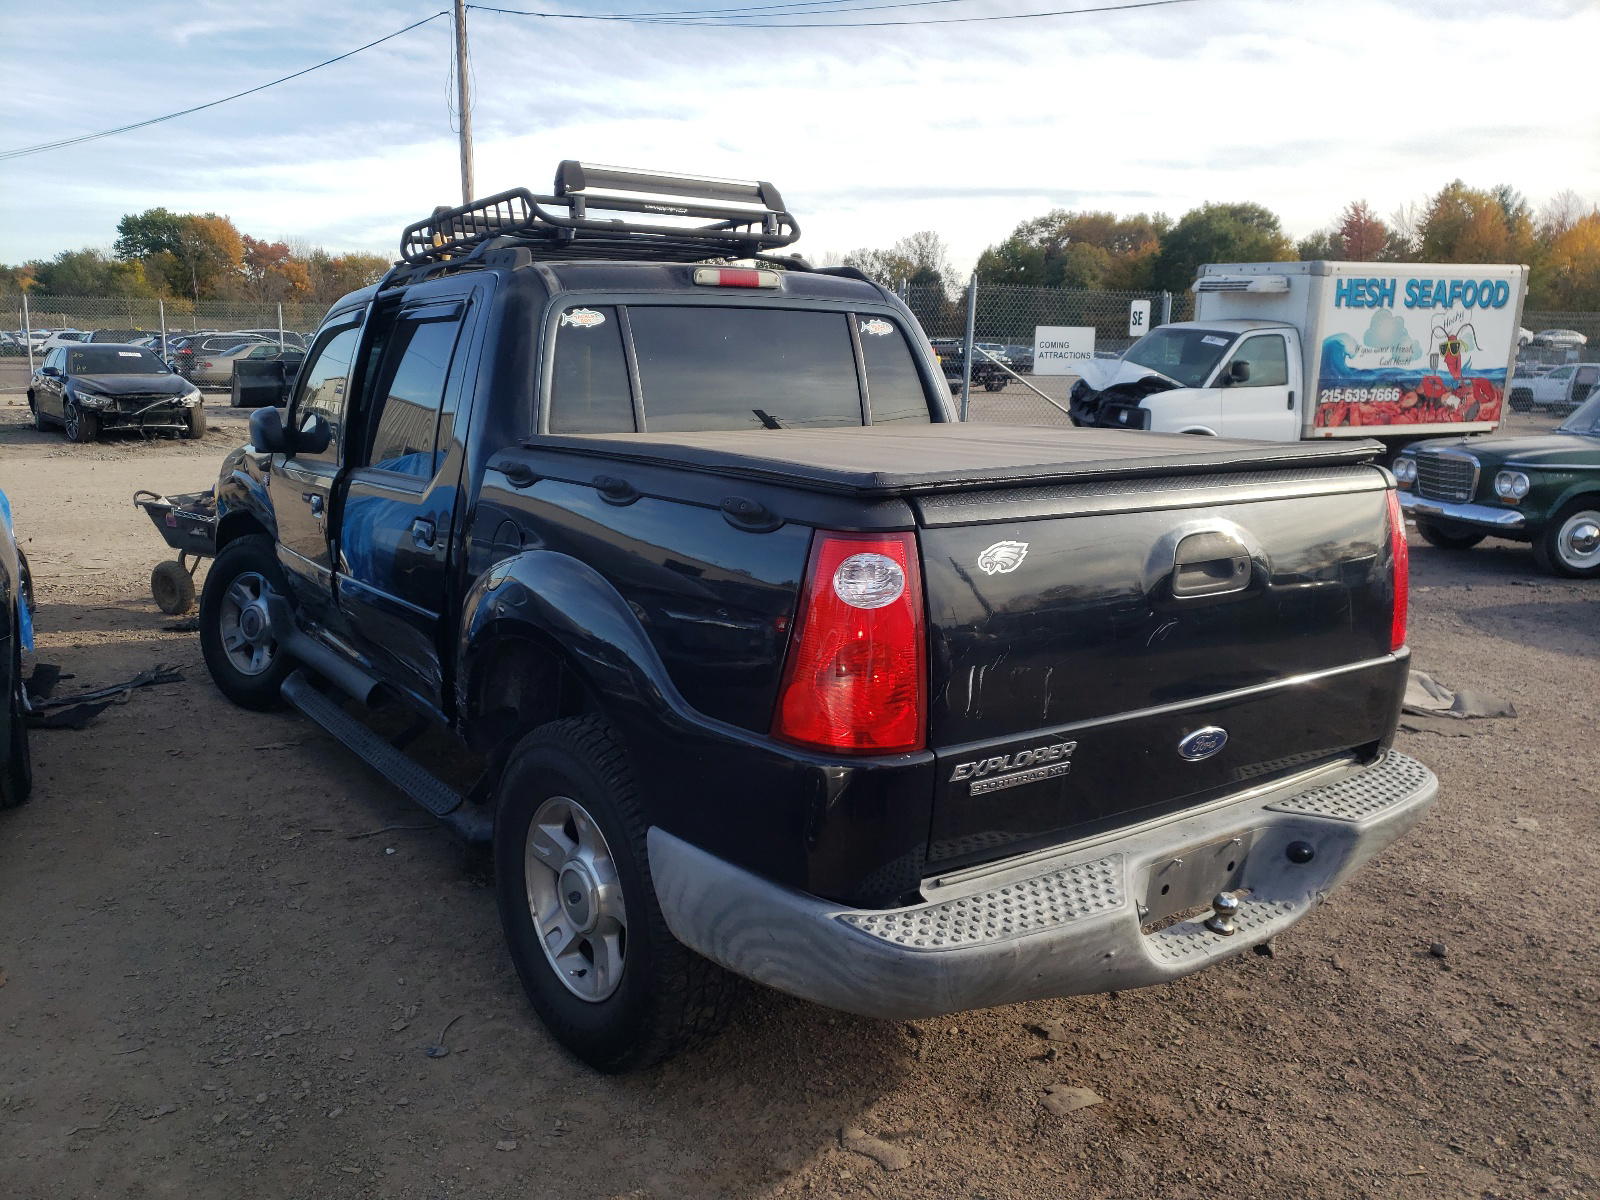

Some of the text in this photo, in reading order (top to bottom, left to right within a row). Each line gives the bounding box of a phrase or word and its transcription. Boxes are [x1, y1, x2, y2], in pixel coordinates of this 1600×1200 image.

[1335, 278, 1510, 309] HESH SEAFOOD
[1132, 311, 1144, 326] SE
[1039, 341, 1070, 349] COMING
[1360, 346, 1373, 357] you
[1038, 351, 1091, 360] ATTRACTIONS
[1379, 356, 1393, 366] Call
[1320, 388, 1400, 403] 215-639-7666
[1192, 735, 1219, 752] Ford
[950, 741, 1078, 782] EXPLORER
[1050, 764, 1069, 775] XLT
